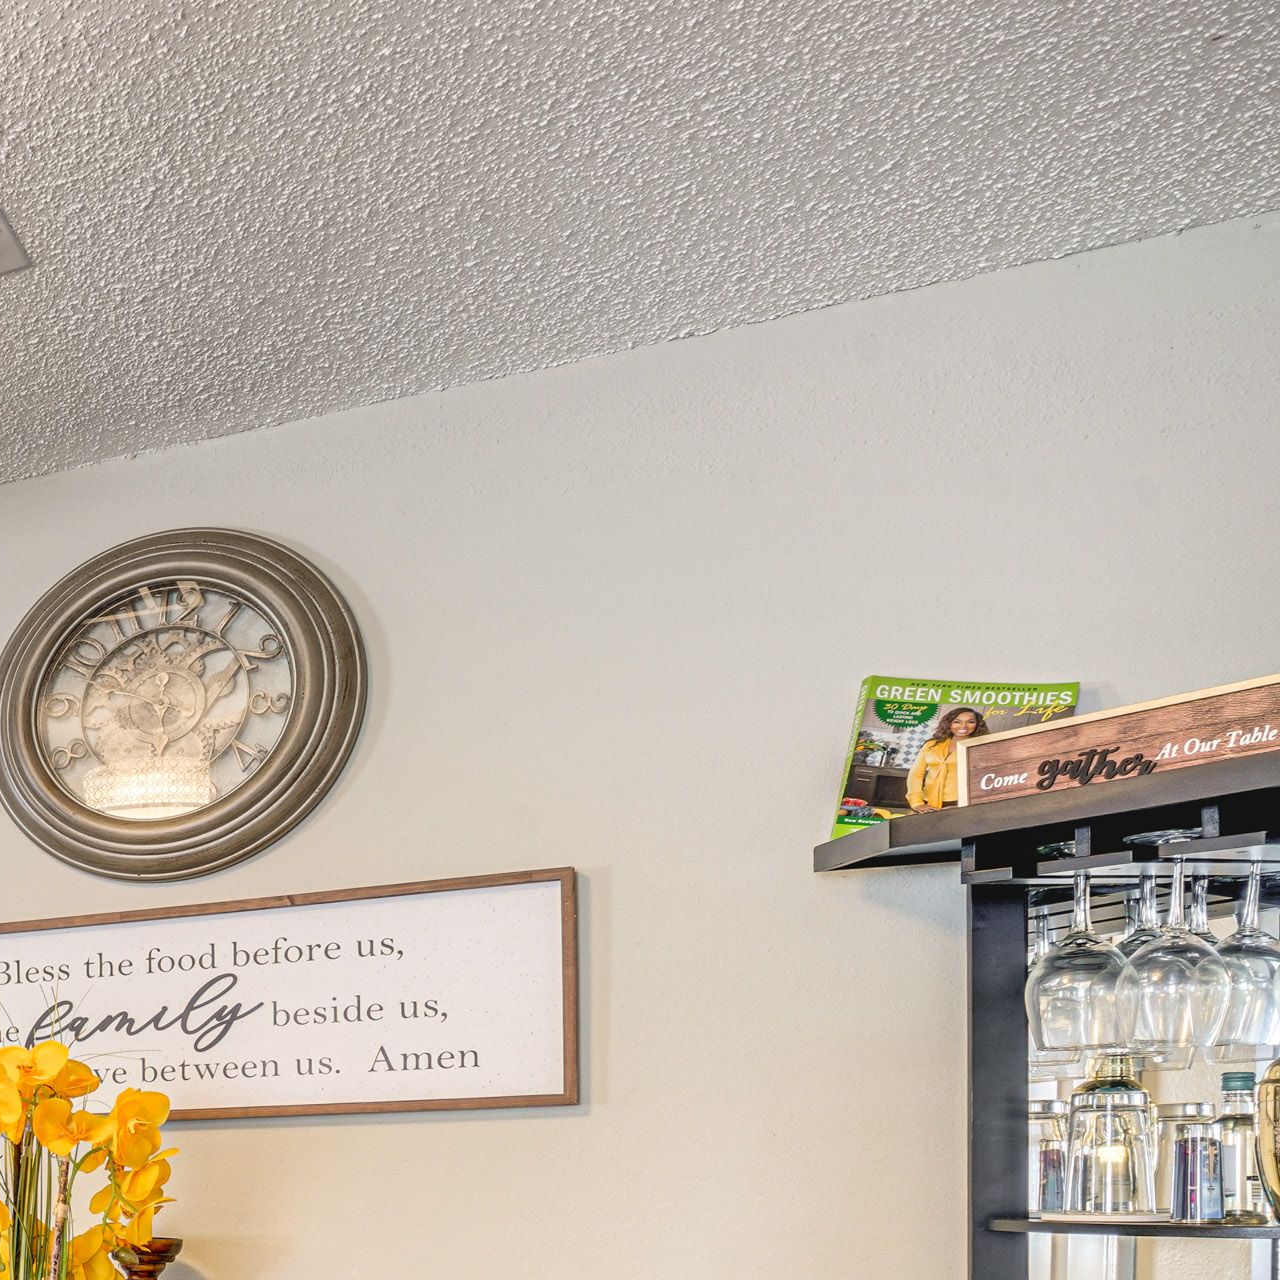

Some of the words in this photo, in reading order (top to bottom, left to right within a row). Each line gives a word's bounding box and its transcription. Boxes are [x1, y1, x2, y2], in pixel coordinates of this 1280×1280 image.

[107, 602, 143, 645] 11
[155, 587, 204, 628] 12
[213, 600, 242, 637] 1
[57, 637, 107, 680] 10
[238, 633, 282, 671] 2
[44, 692, 81, 717] 9
[248, 690, 290, 715] 3
[876, 685, 942, 702] GREEN
[948, 689, 1073, 706] SMOOTHIES
[901, 703, 929, 712] Days
[982, 706, 1007, 720] for
[1014, 699, 1069, 722] Life
[51, 737, 88, 769] 8
[231, 737, 269, 772] 4
[980, 771, 1028, 791] Come
[1036, 746, 1158, 791] gather
[1155, 742, 1179, 761] At
[1183, 738, 1221, 756] Our
[1225, 725, 1278, 748] Table
[83, 952, 134, 979] the
[145, 943, 218, 974] food
[231, 937, 342, 968] before
[355, 937, 405, 961] us,
[24, 972, 265, 1053] family
[271, 994, 385, 1027] beside
[398, 998, 449, 1023] us,
[140, 1057, 281, 1084] between
[295, 1055, 341, 1077] us.
[367, 1045, 481, 1073] Amen
